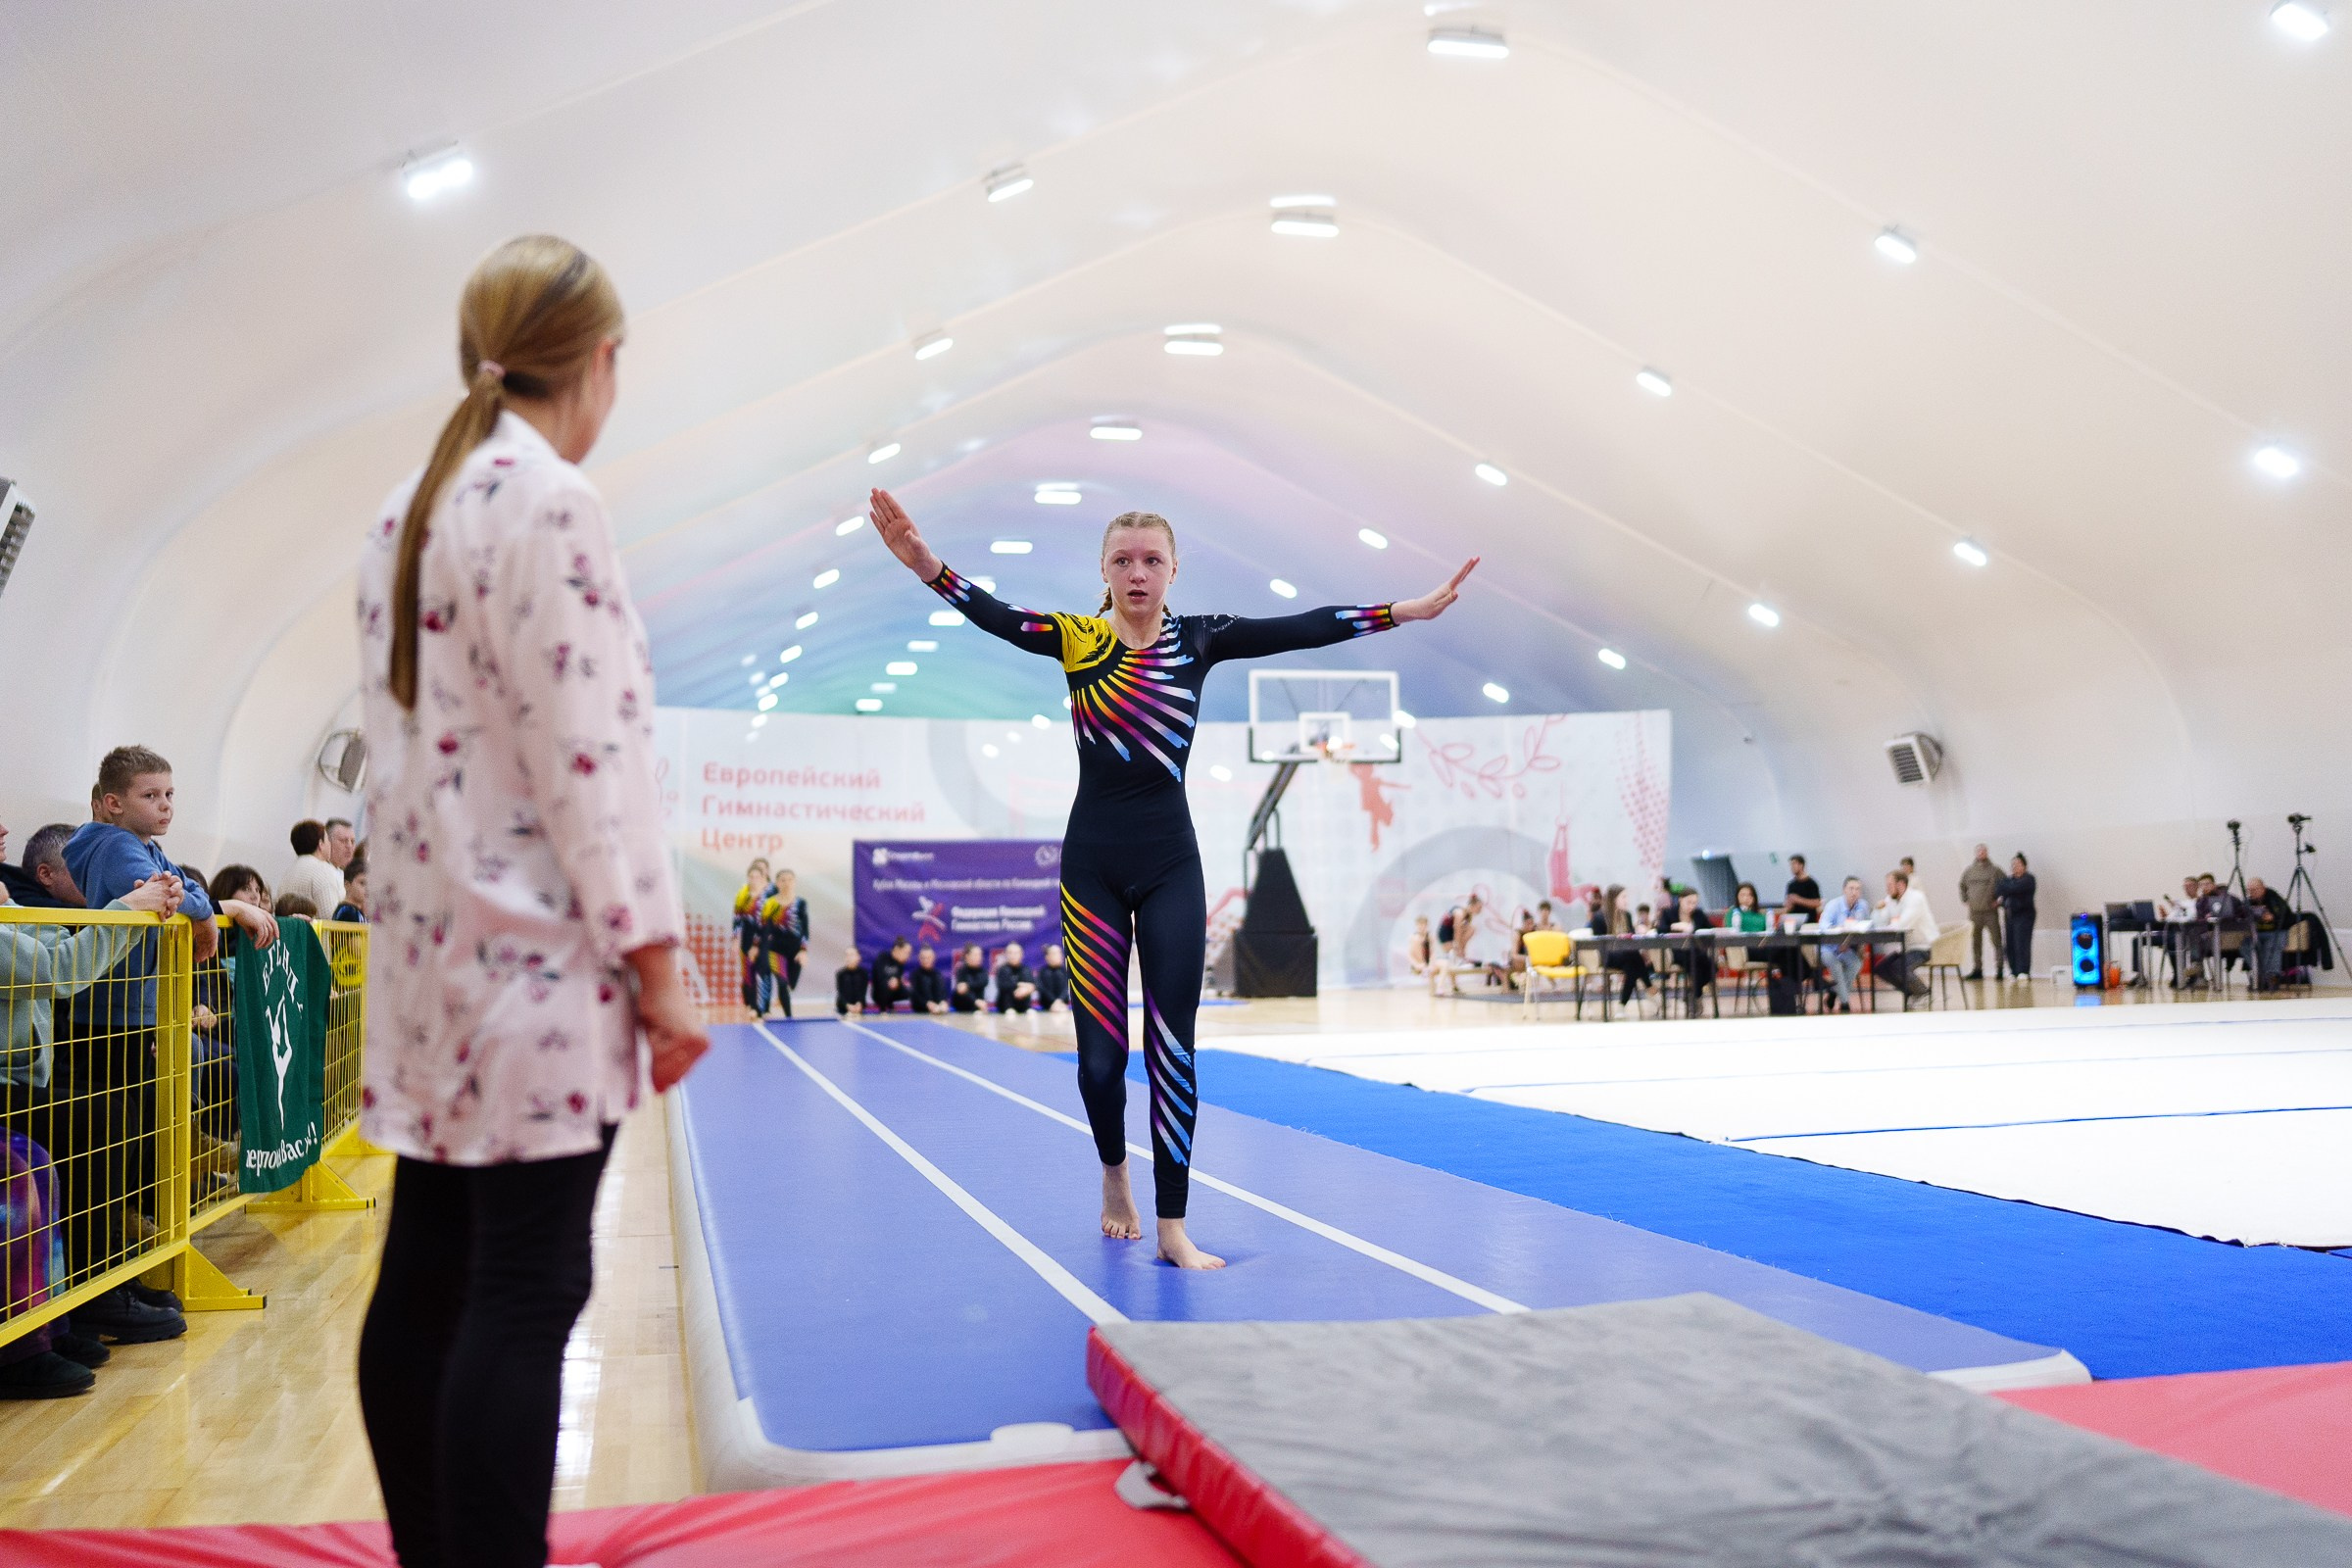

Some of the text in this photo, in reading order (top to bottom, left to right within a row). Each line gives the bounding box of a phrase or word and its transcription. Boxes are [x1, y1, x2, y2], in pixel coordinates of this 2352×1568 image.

[703, 760, 881, 790] Европейский
[701, 793, 926, 823] Гимнастический
[700, 827, 784, 854] Центр
